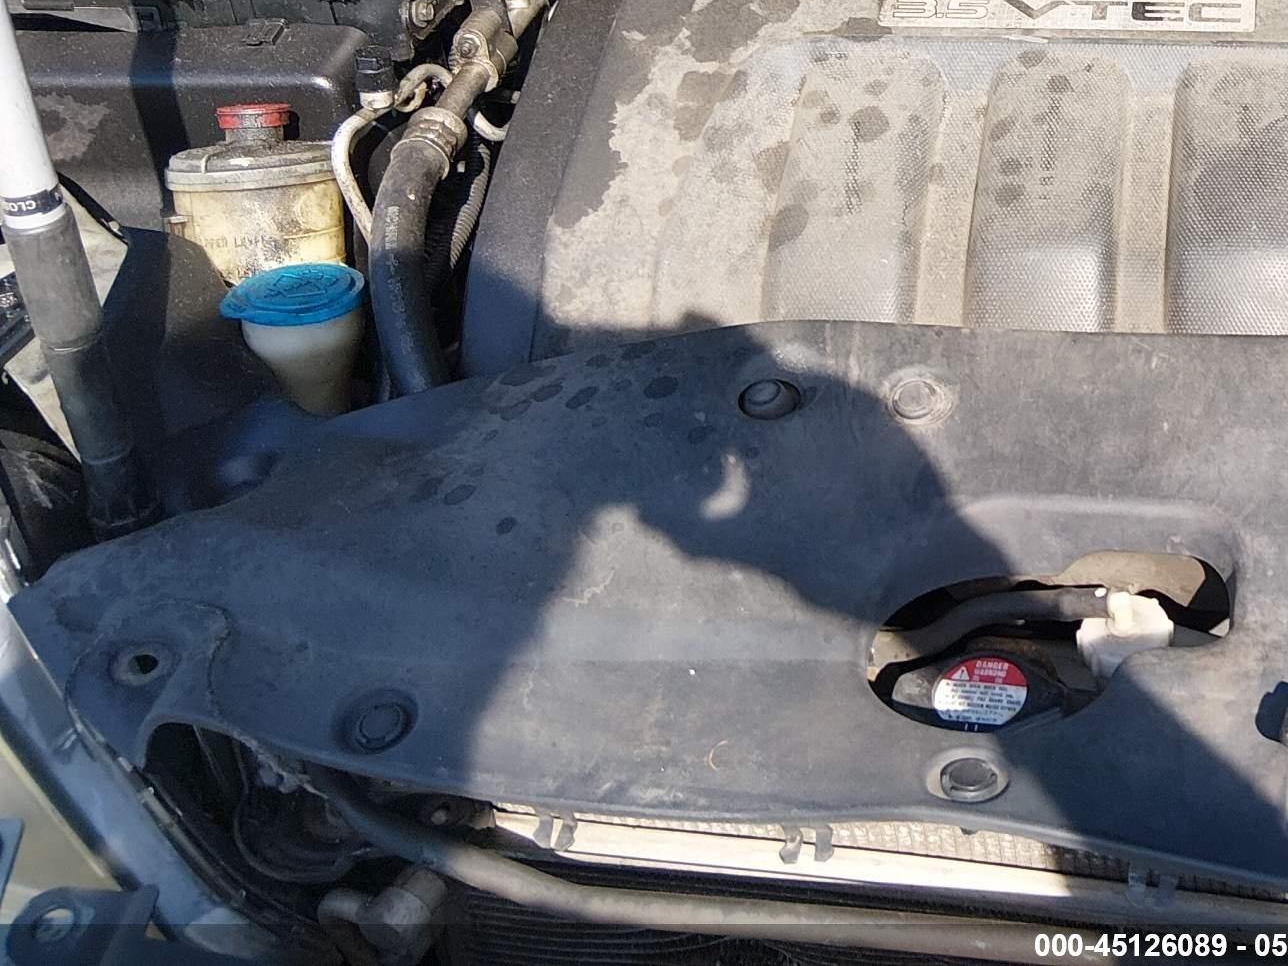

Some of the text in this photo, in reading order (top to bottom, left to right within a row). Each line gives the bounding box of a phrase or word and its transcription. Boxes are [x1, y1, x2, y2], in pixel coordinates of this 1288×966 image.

[1003, 0, 1243, 23] VTEC
[6, 200, 36, 212] CLO
[975, 660, 1009, 670] DANGER
